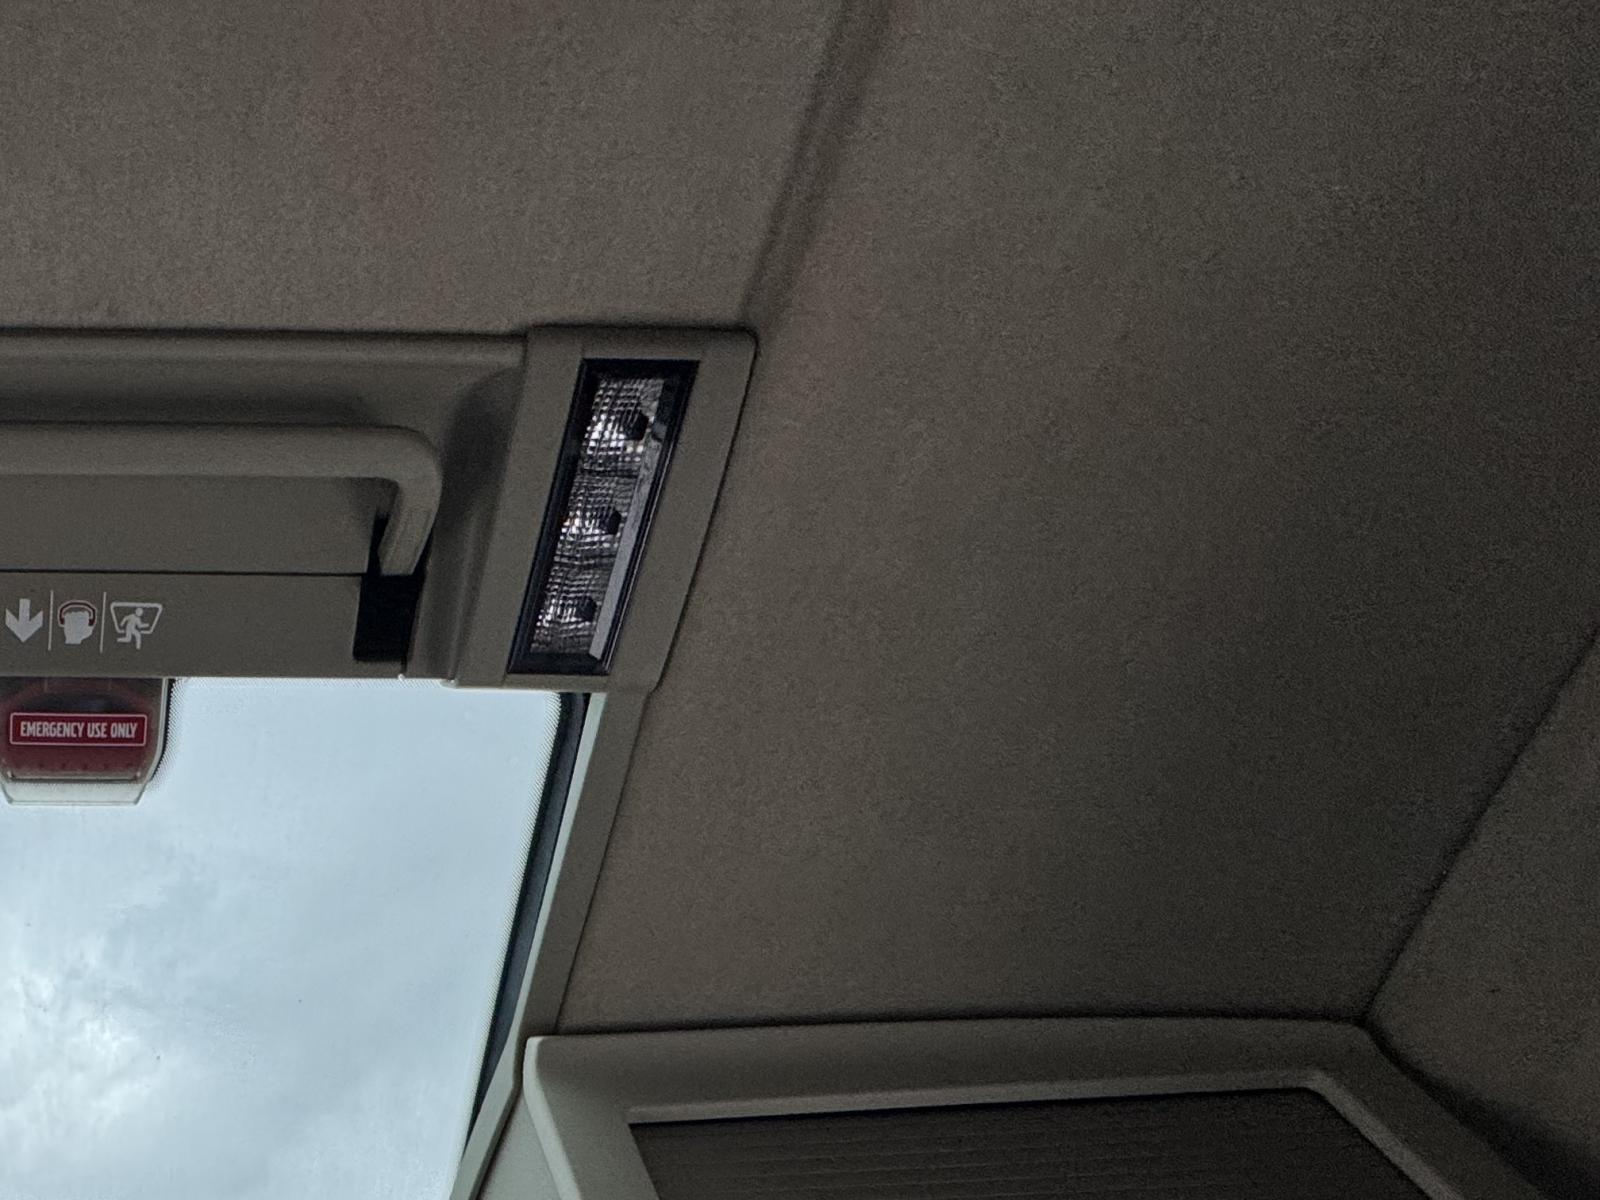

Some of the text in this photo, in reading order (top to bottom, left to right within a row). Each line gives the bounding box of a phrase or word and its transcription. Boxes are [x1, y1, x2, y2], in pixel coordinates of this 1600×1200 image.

[20, 721, 138, 739] EMERGENCY USE ONLY
